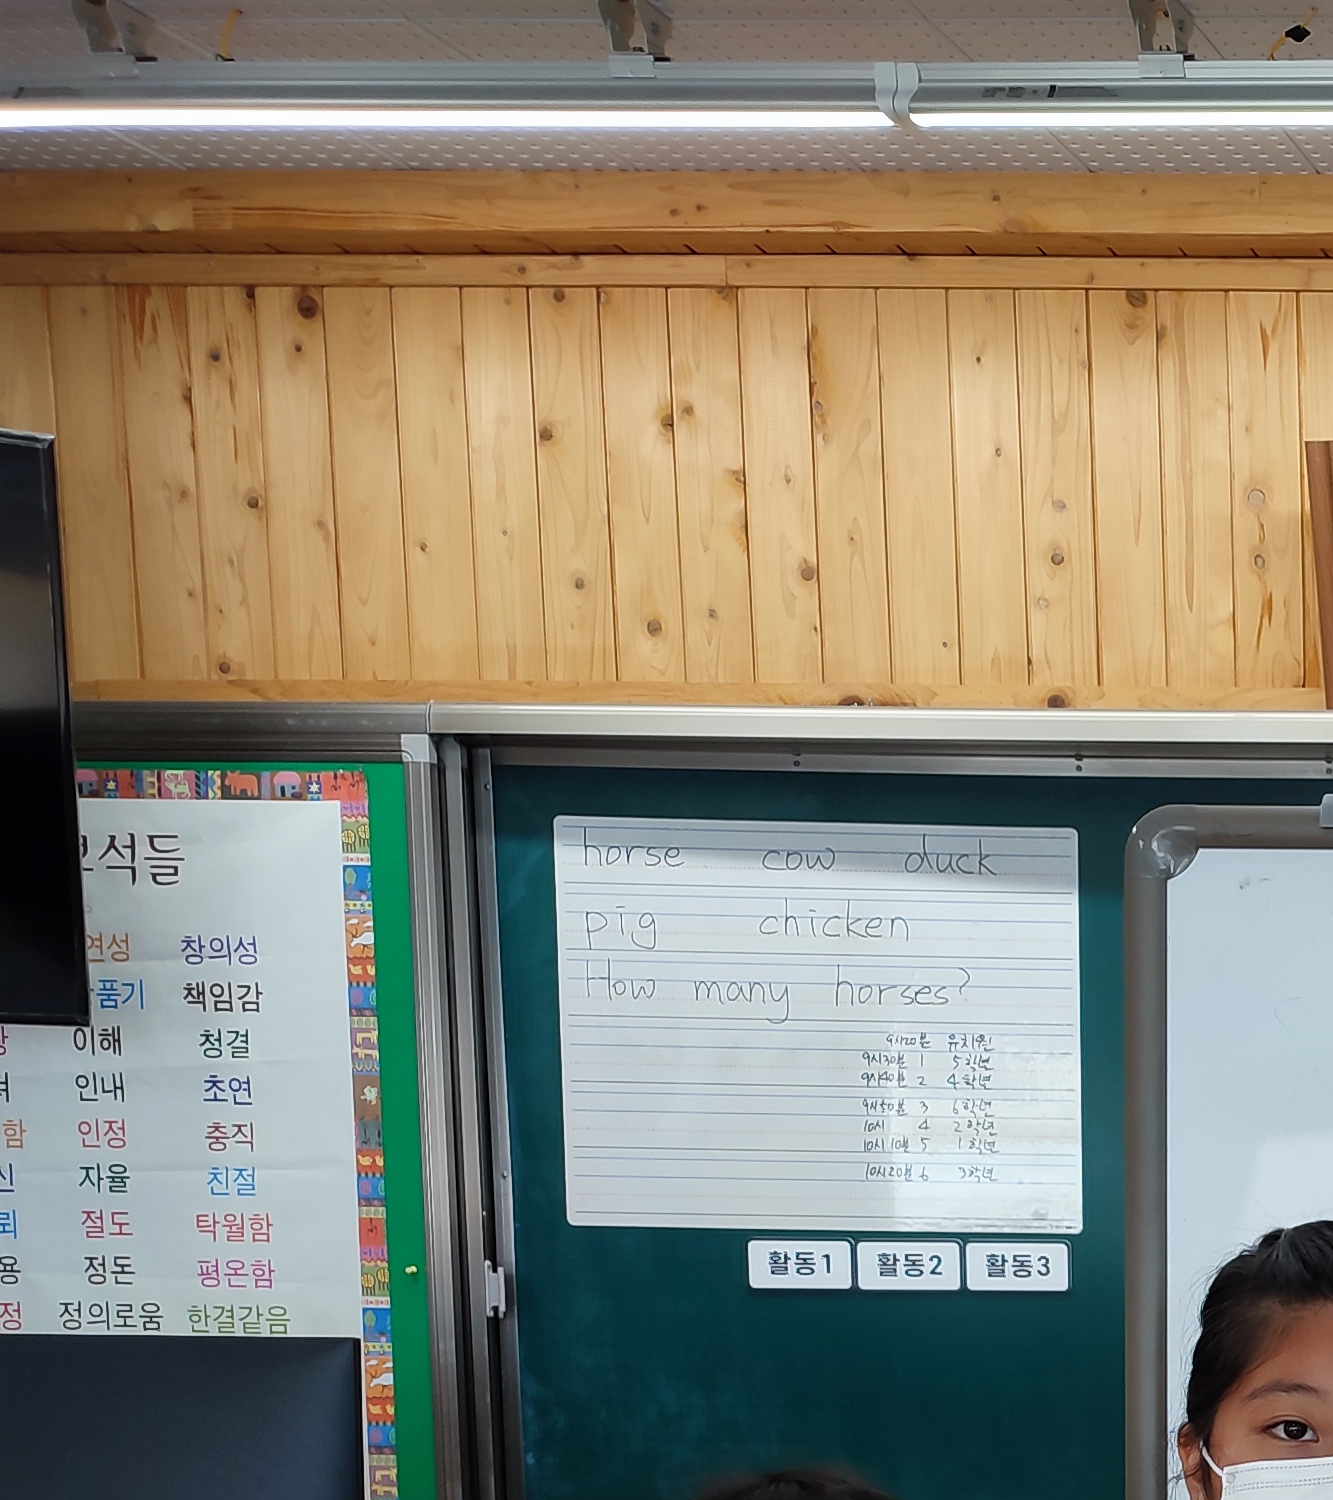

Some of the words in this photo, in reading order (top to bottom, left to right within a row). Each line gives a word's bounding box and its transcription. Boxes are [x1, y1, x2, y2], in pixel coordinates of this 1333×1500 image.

[582, 827, 686, 869] horse
[762, 845, 837, 872] cow
[904, 833, 998, 877] duck
[584, 904, 658, 950] pig
[758, 896, 910, 941] chicken
[180, 934, 260, 966] 창의성
[90, 977, 146, 1010] 품기
[182, 981, 264, 1014] 책임감
[585, 957, 657, 1003] How
[693, 978, 790, 1024] many
[833, 963, 972, 1007] horses?
[73, 1024, 123, 1056] 이해
[198, 1028, 251, 1060] 청결
[75, 1071, 126, 1103] 인내
[202, 1074, 254, 1107] 초연
[77, 1118, 128, 1149] 인정
[204, 1121, 256, 1154] 충직
[78, 1162, 131, 1194] 자율
[206, 1166, 258, 1198] 친절
[80, 1209, 134, 1239] 절도
[195, 1211, 274, 1244] 탁월함
[83, 1254, 136, 1285] 정돈
[196, 1258, 276, 1290] 평온함
[768, 1250, 833, 1277] 활동1
[876, 1250, 944, 1278] 활동2
[985, 1251, 1052, 1279] 활동3
[58, 1300, 165, 1333] 정의로움
[187, 1303, 292, 1335] 한결같음
